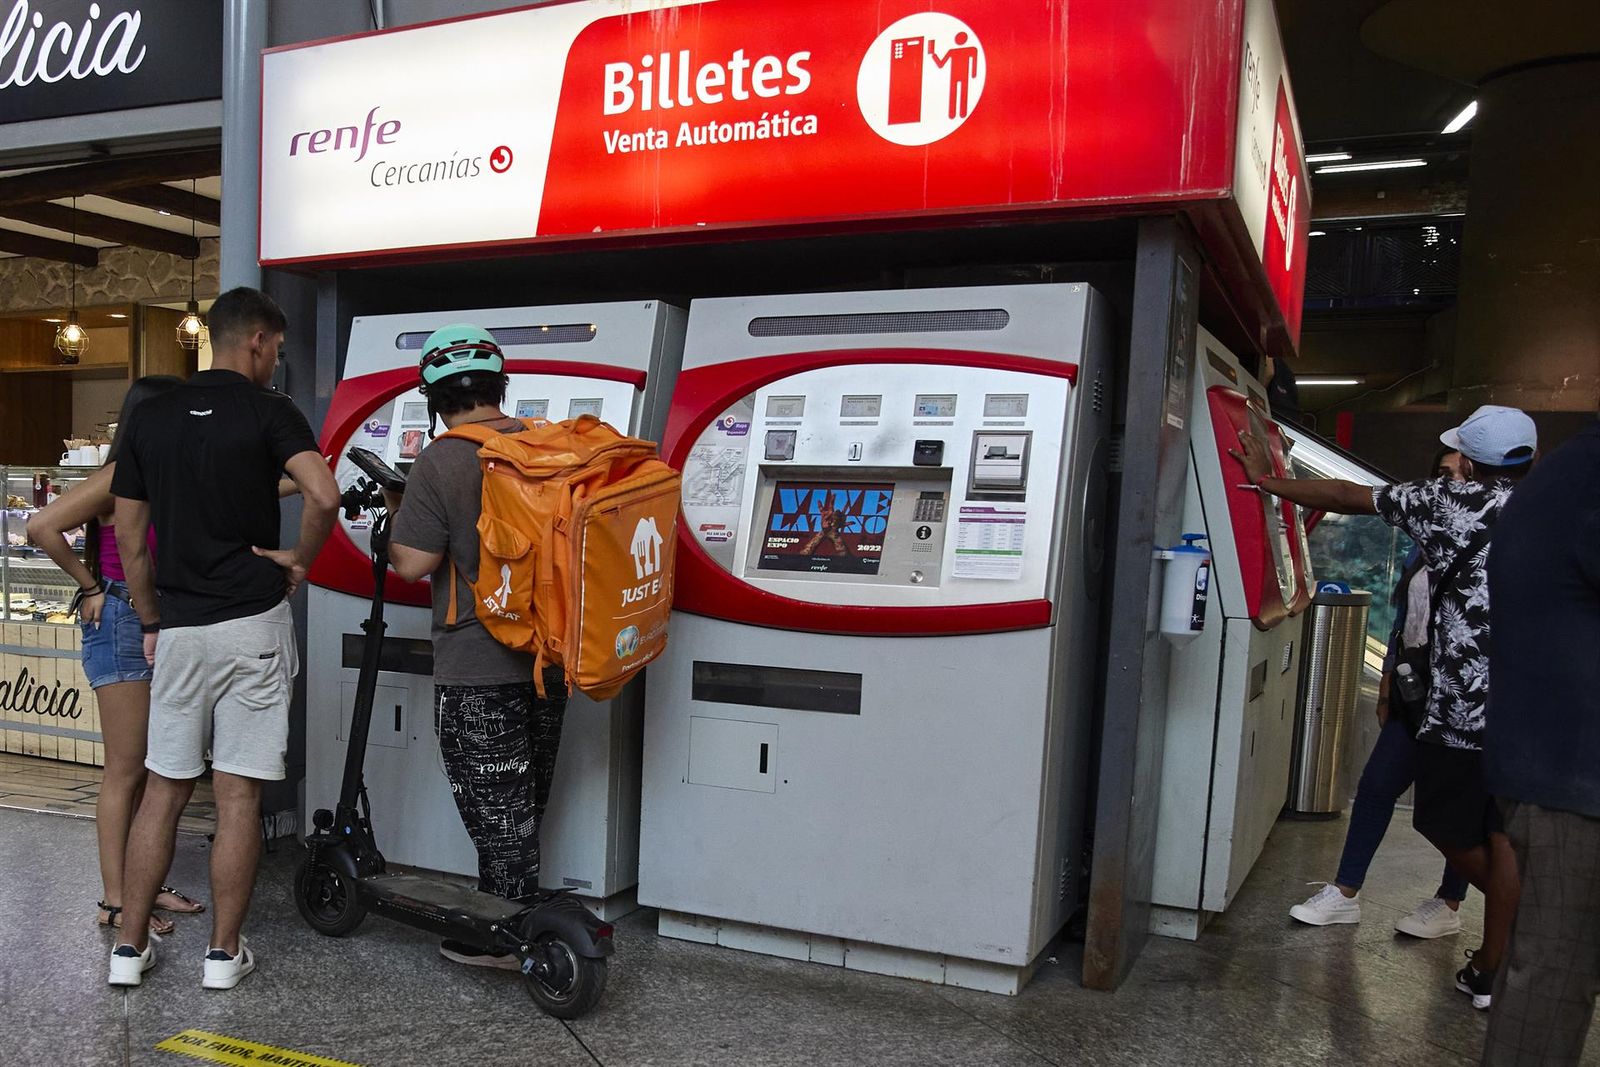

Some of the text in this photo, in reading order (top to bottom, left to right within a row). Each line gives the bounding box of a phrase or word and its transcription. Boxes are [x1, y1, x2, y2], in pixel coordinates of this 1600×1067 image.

[603, 49, 811, 116] Billetes
[289, 106, 402, 163] renfe
[603, 110, 818, 154] Venta Automática
[370, 150, 482, 187] Cercanías
[780, 488, 893, 516] VIVE
[621, 582, 651, 608] JUST
[173, 1034, 207, 1046] POR
